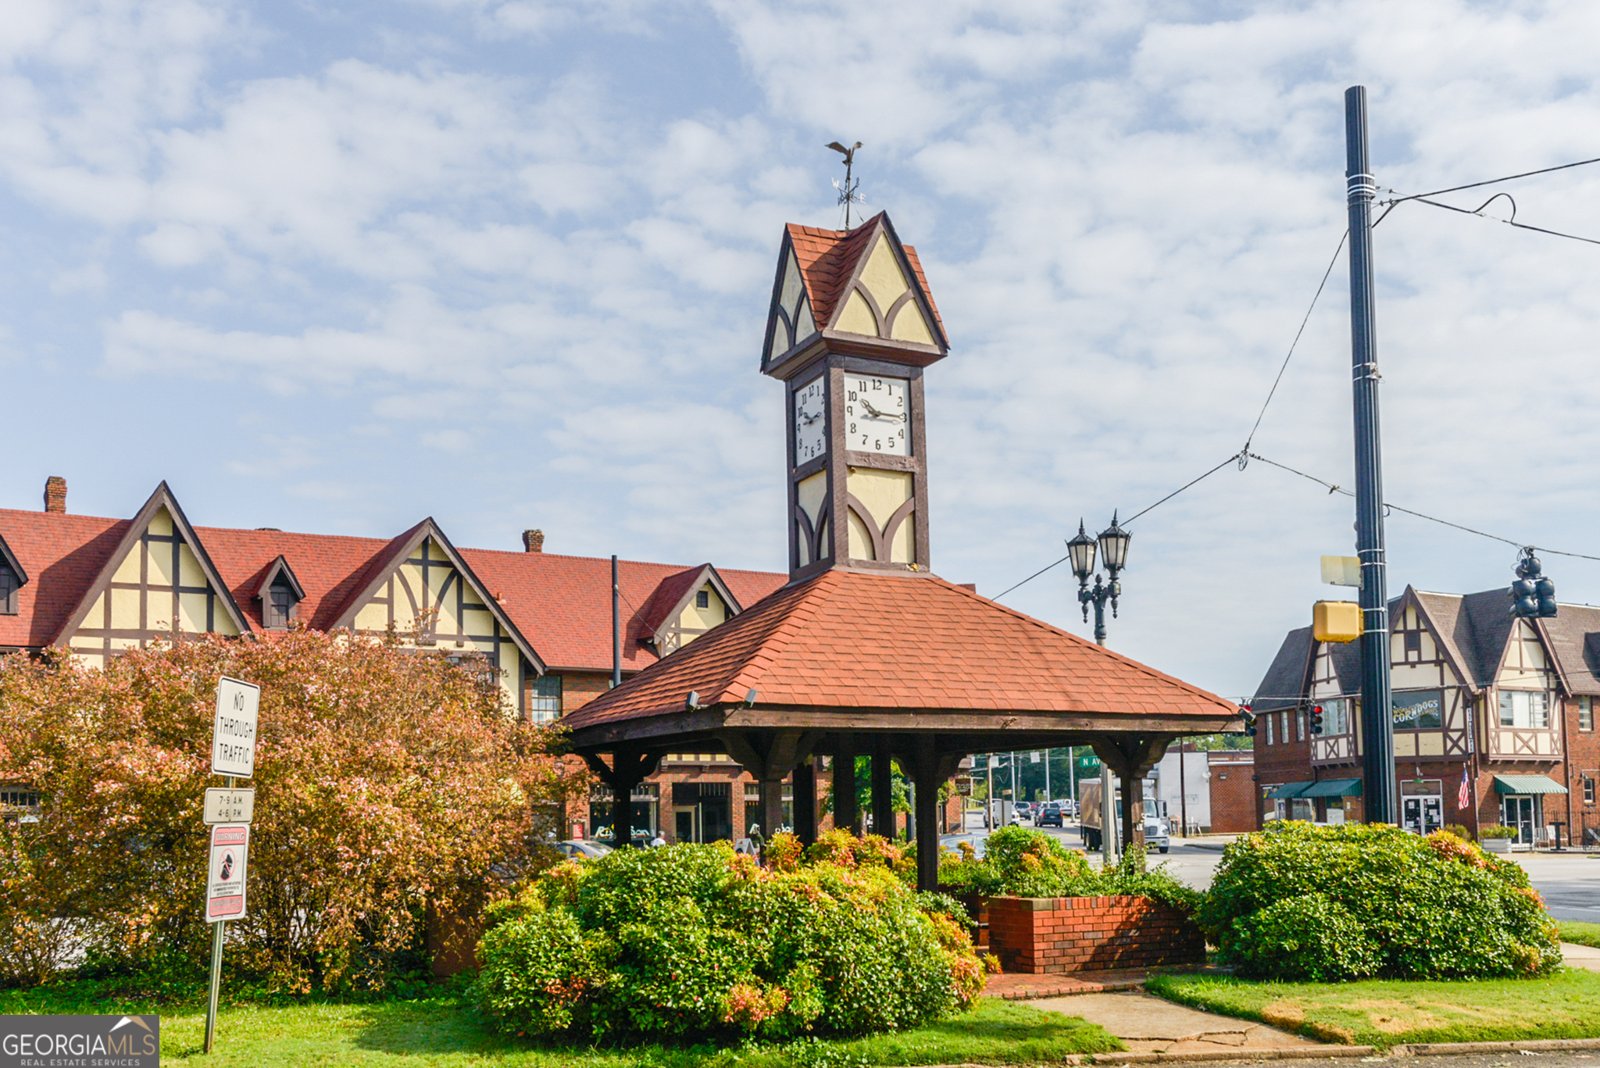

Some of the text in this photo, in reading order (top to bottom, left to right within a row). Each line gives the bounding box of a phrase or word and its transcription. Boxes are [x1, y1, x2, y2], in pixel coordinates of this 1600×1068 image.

[859, 381, 867, 392] 11
[872, 379, 882, 390] 12
[888, 384, 892, 396] 1
[809, 385, 814, 397] 12
[848, 390, 857, 402] 10
[802, 393, 807, 405] 11
[897, 397, 903, 407] 2
[798, 406, 803, 418] 10
[847, 406, 853, 416] 9
[850, 423, 857, 434] 8
[898, 429, 904, 439] 4
[817, 439, 821, 451] 5
[862, 435, 868, 445] 7
[875, 440, 881, 450] 6
[888, 437, 895, 448] 5
[804, 445, 808, 457] 7
[233, 691, 244, 711] NO
[219, 716, 253, 739] THROUGH
[219, 743, 250, 764] TRAFFIC
[1083, 758, 1088, 766] N
[219, 795, 230, 805] 7-9
[218, 808, 229, 818] 4-6
